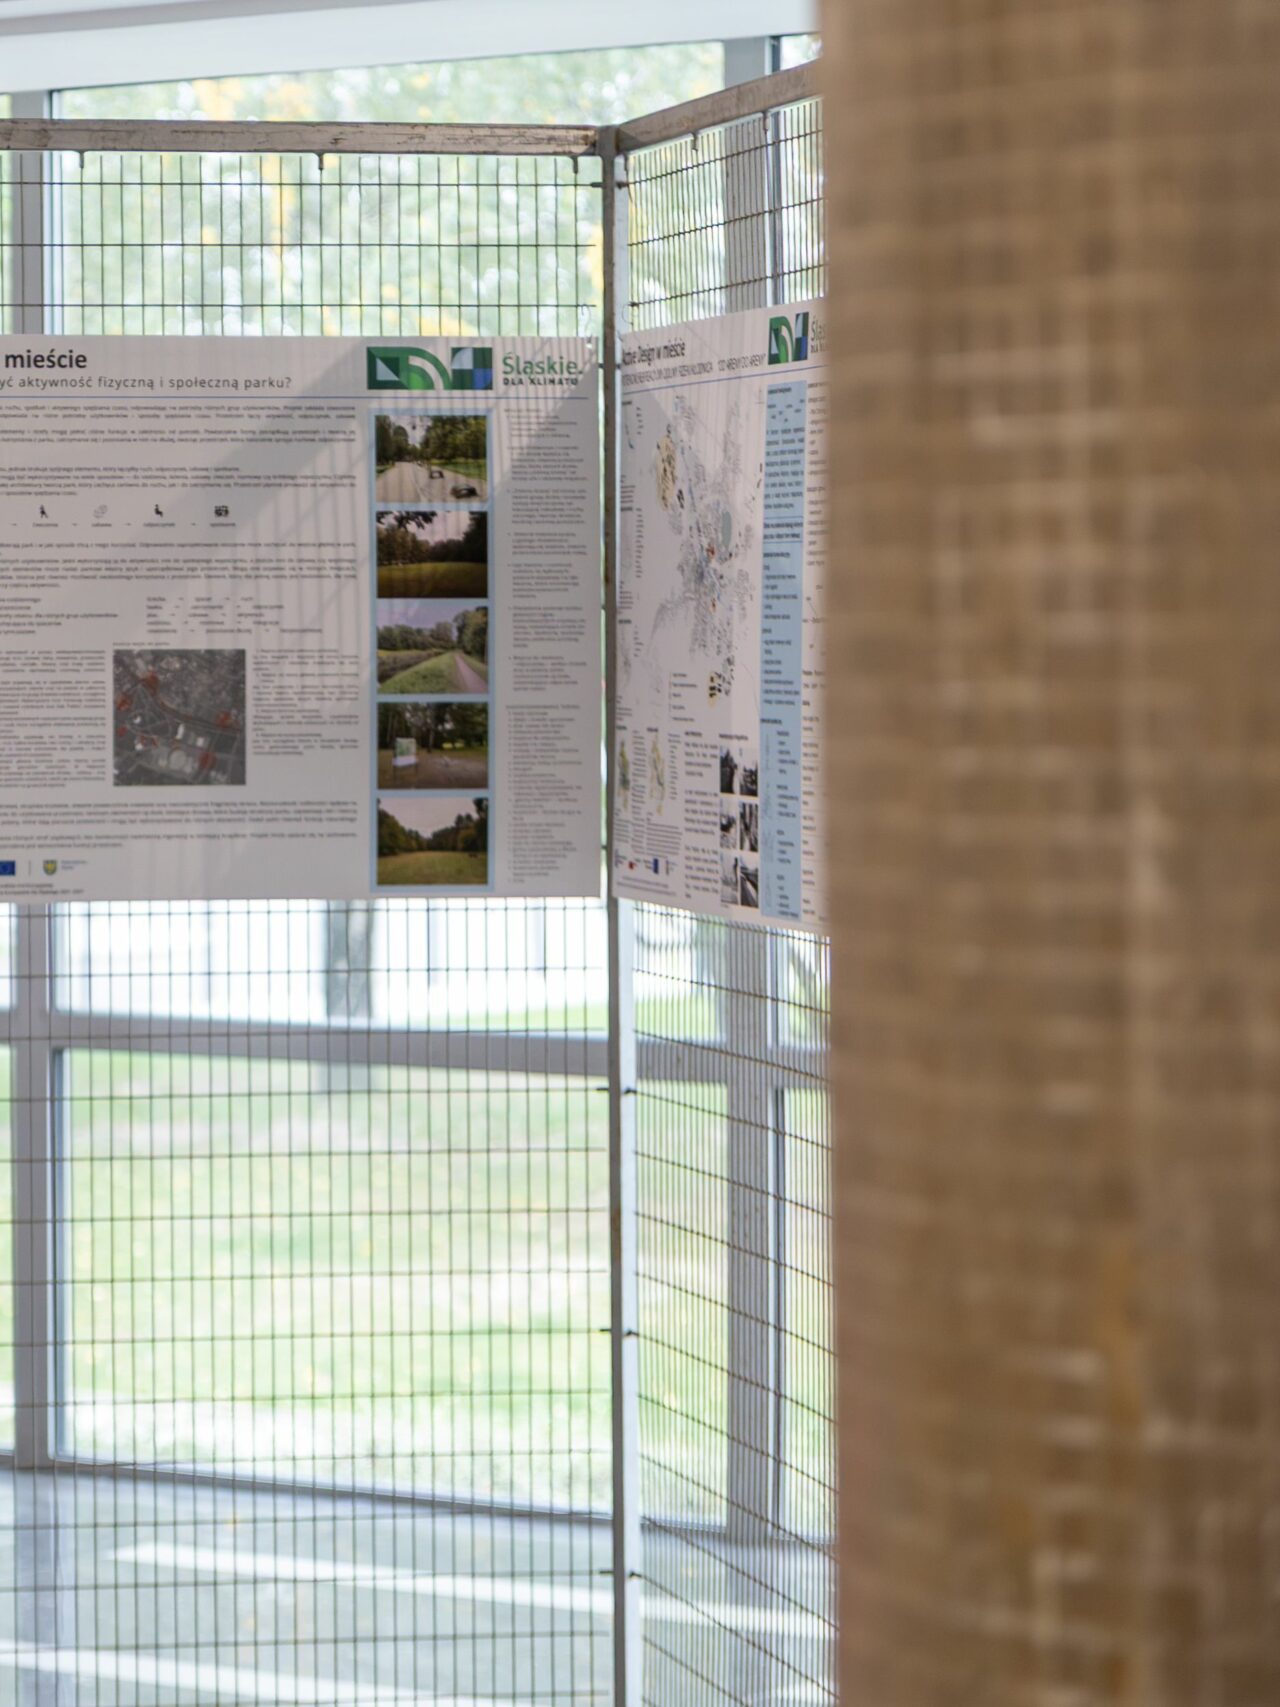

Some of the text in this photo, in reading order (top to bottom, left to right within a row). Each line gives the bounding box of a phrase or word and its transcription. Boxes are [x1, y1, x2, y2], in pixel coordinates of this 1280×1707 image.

[5, 348, 88, 368] mieście
[19, 376, 93, 390] aktywność
[98, 376, 155, 391] fizyczną
[159, 376, 164, 388] i
[168, 376, 239, 391] społeczną
[244, 376, 292, 390] parku?
[503, 377, 579, 386] DLA KLIMATU
